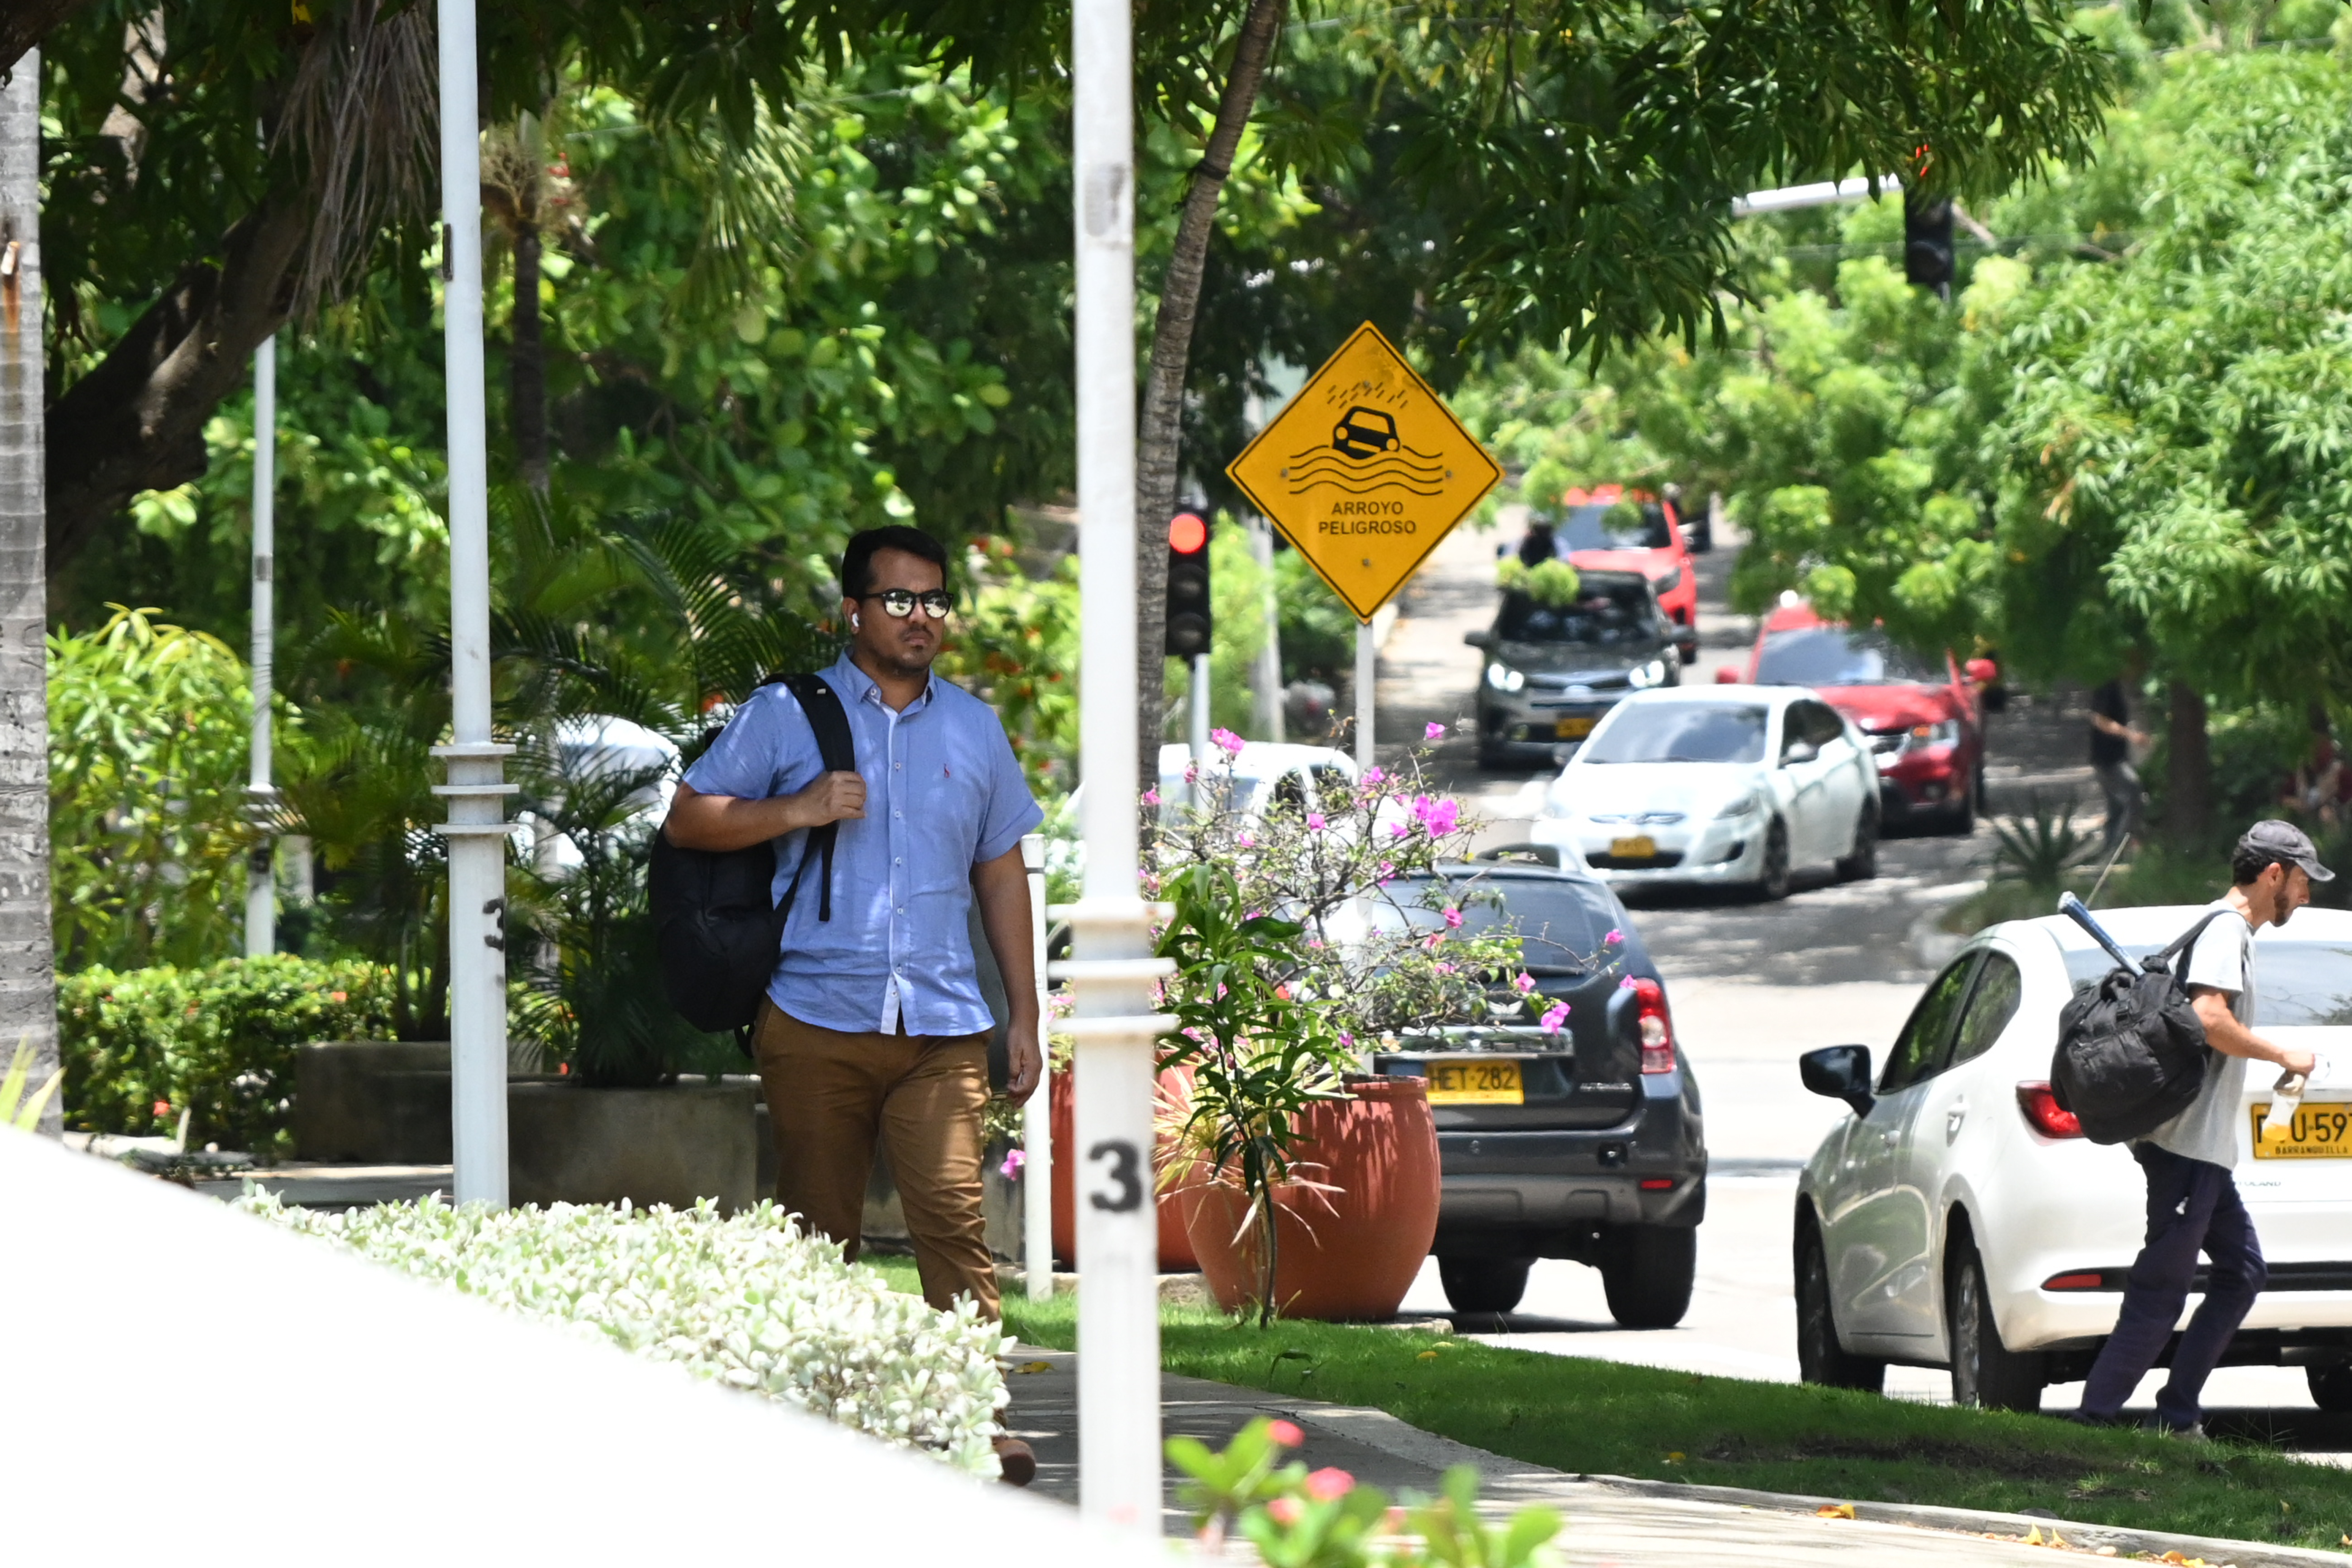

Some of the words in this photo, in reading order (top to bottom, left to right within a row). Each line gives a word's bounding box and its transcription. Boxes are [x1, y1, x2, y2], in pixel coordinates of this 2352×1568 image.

[1331, 501, 1404, 515] ARROYO
[1318, 520, 1416, 534] PELIGROSO
[1089, 1139, 1142, 1213] 3
